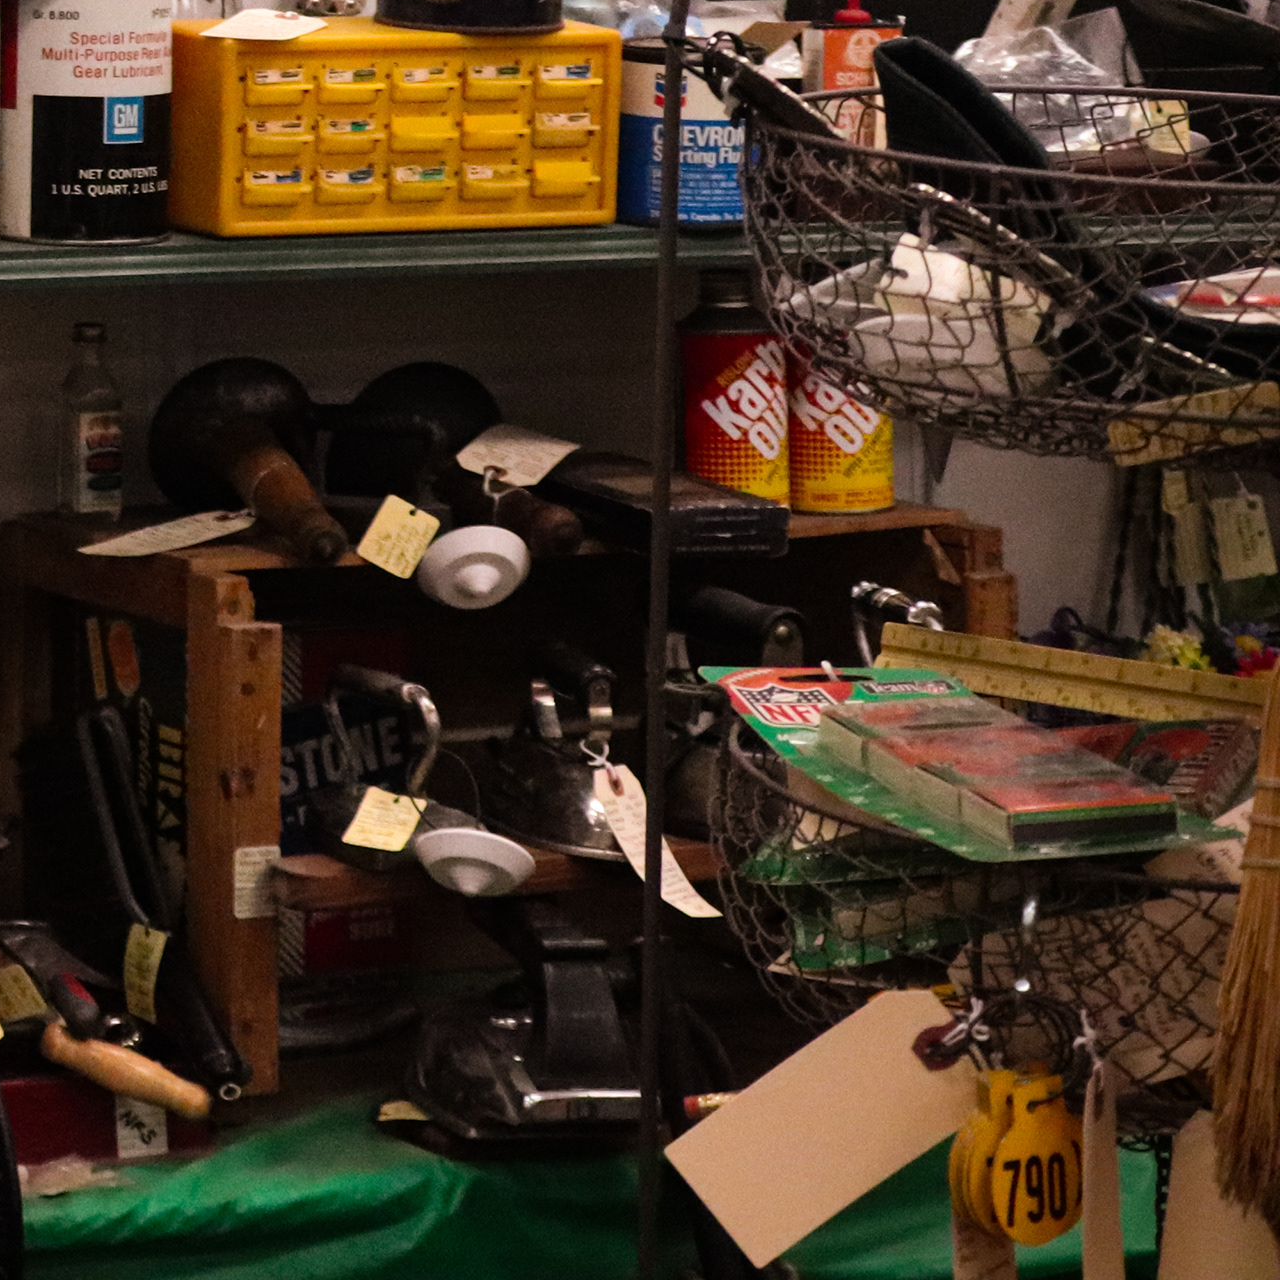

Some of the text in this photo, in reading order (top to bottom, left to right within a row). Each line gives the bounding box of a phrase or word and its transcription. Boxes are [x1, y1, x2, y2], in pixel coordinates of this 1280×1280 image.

[70, 30, 167, 46] Special Formula
[41, 47, 139, 63] Multi-Purpose
[73, 64, 164, 78] Gear Lubricant
[114, 104, 138, 128] GM
[653, 125, 745, 147] CEVRON
[653, 145, 717, 168] Srting
[79, 167, 158, 180] NET CONTENTS
[62, 185, 84, 195] U.S.
[133, 184, 139, 194] 2
[1003, 1152, 1067, 1228] 790
